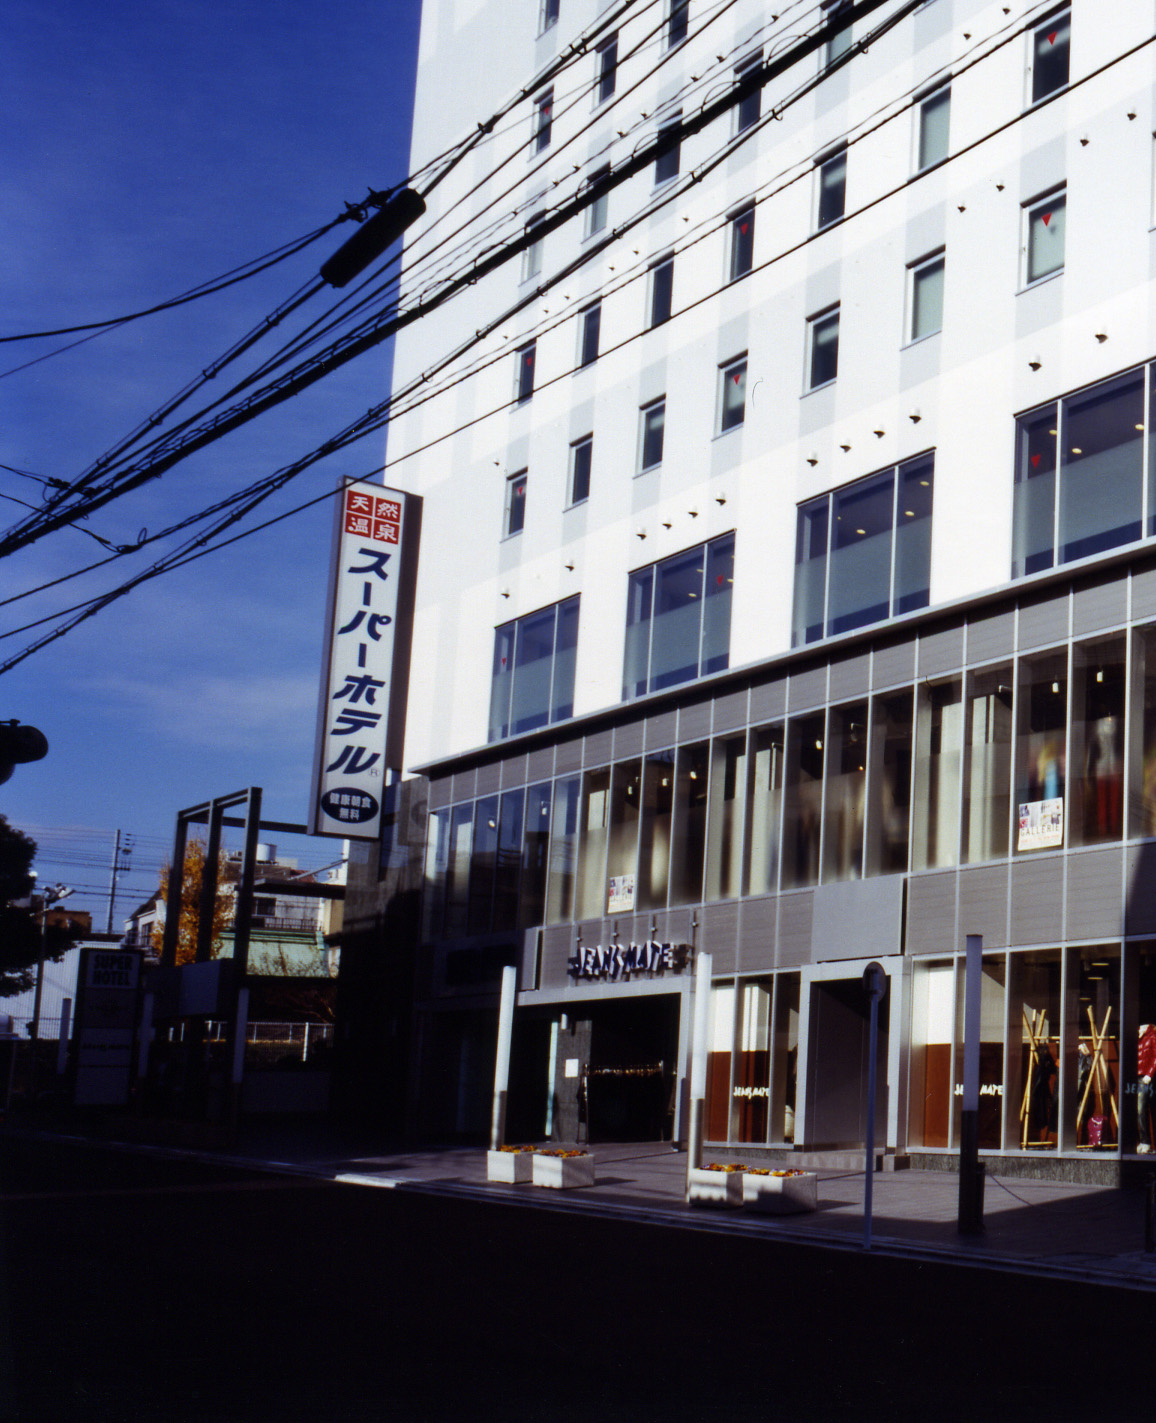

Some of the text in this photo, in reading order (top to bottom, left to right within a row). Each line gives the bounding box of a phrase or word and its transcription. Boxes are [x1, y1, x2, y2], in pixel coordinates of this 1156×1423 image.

[351, 496, 398, 518] 天然
[348, 517, 397, 541] 温泉
[326, 548, 392, 774] スーパーホテル
[94, 955, 132, 970] SUPER
[92, 970, 130, 985] HOTEL
